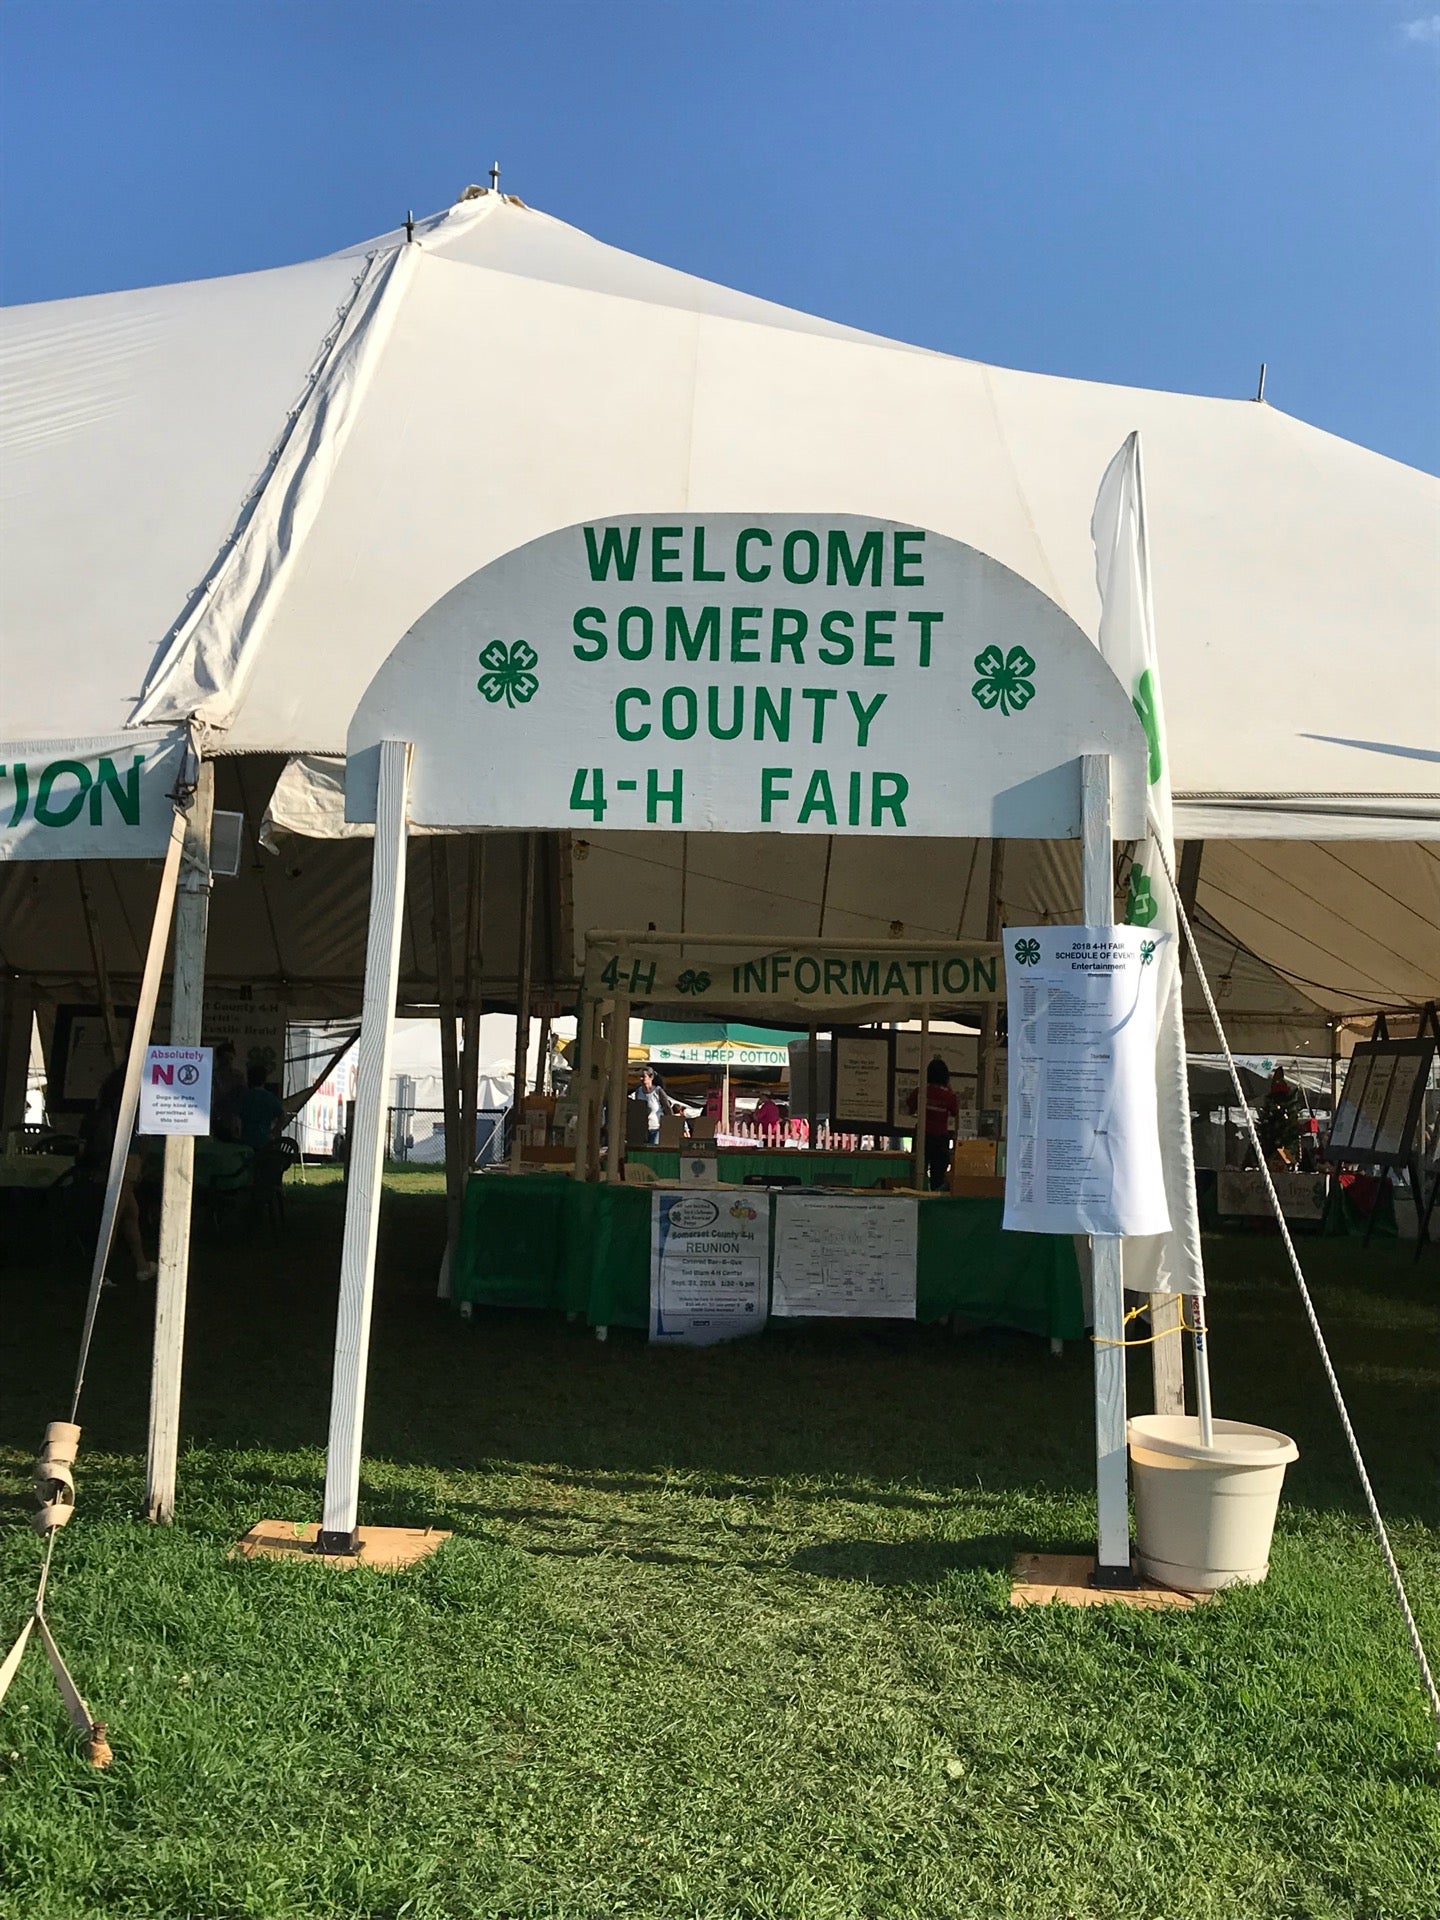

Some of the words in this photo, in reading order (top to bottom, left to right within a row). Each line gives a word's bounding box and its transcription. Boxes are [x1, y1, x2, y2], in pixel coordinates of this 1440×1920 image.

[583, 526, 925, 587] WELCOME
[573, 606, 944, 667] SOMERSET
[615, 685, 887, 747] COUNTY
[569, 768, 684, 824] 4-H
[761, 767, 910, 827] FAIR
[1072, 942, 1091, 950] 2018
[1092, 942, 1107, 950] 4-H
[1108, 942, 1125, 950] FAIR
[1055, 952, 1098, 960] SCHEDULE
[1099, 952, 1111, 960] OF
[1071, 962, 1126, 970] Entertainment
[600, 954, 657, 996] 4-H
[732, 956, 998, 998] INFORMATION
[151, 1050, 204, 1062] Absolutely
[740, 1050, 787, 1063] COTTON
[671, 1230, 709, 1240] Somerset
[711, 1229, 738, 1240] County
[686, 1242, 740, 1254] REUNION
